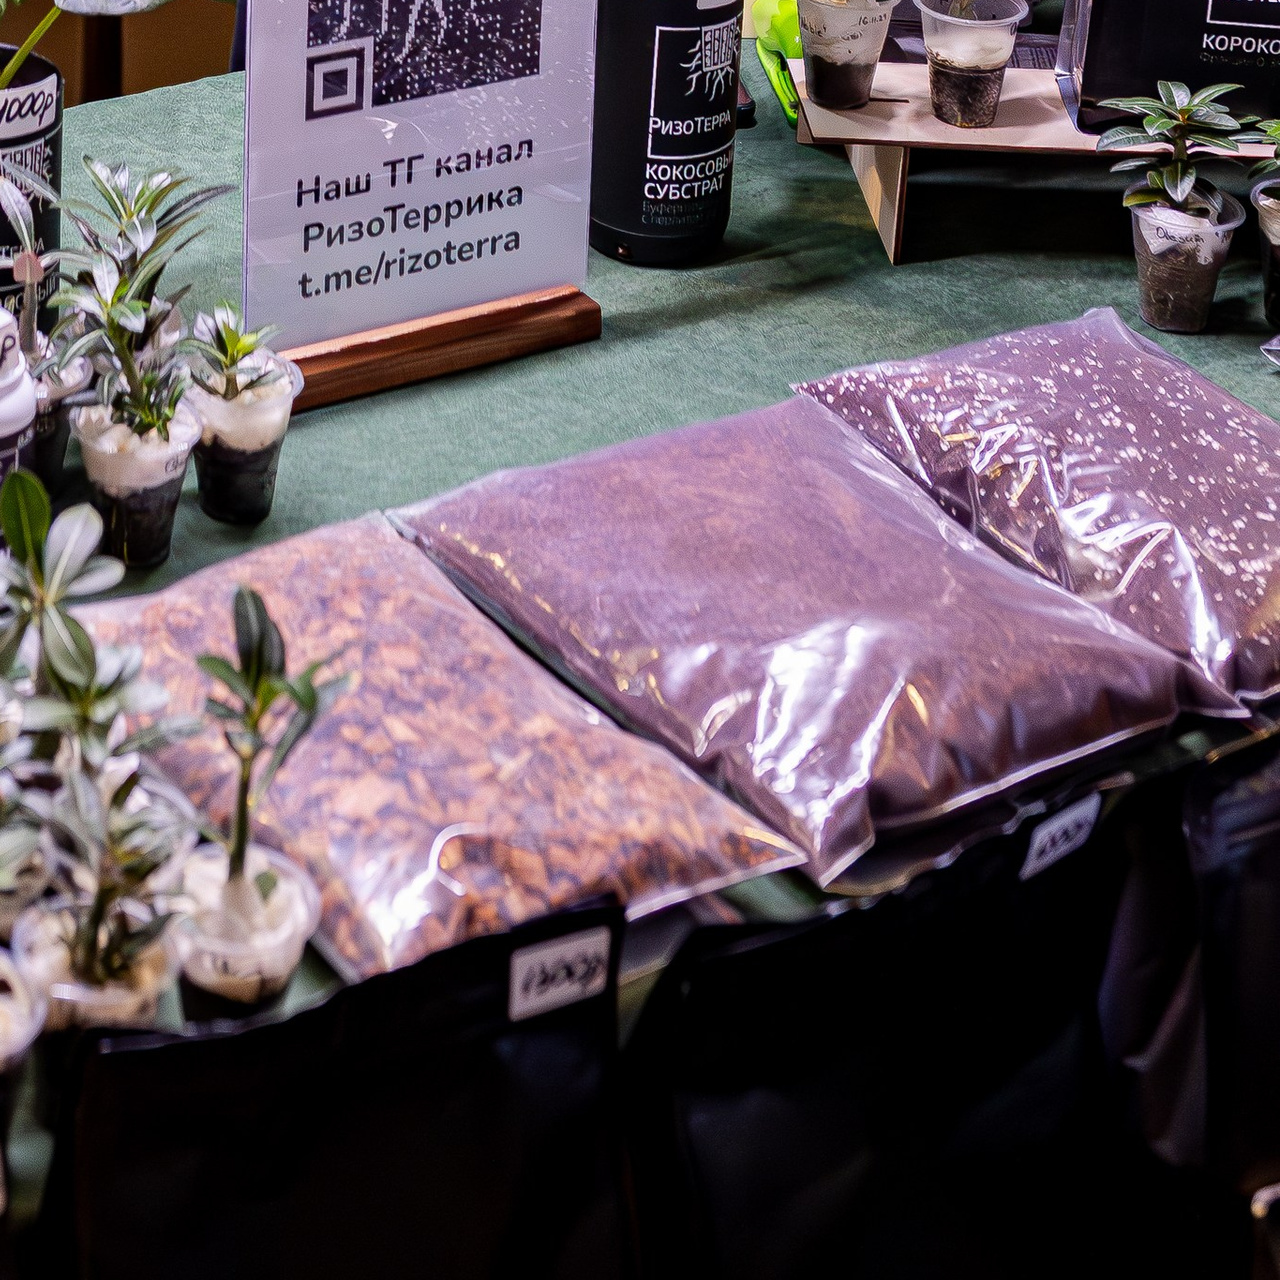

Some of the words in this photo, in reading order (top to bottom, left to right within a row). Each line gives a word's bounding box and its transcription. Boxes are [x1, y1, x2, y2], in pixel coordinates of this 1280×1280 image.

[1202, 33, 1280, 55] КОРОКО
[296, 172, 371, 208] Наш
[383, 153, 424, 188] ТГ
[435, 138, 534, 178] канал
[644, 174, 725, 199] СУБСТРАТ
[645, 149, 733, 181] КОКОСОВЫ
[303, 185, 523, 253] РизоТеррика
[298, 230, 521, 299] t.me/rizoterra
